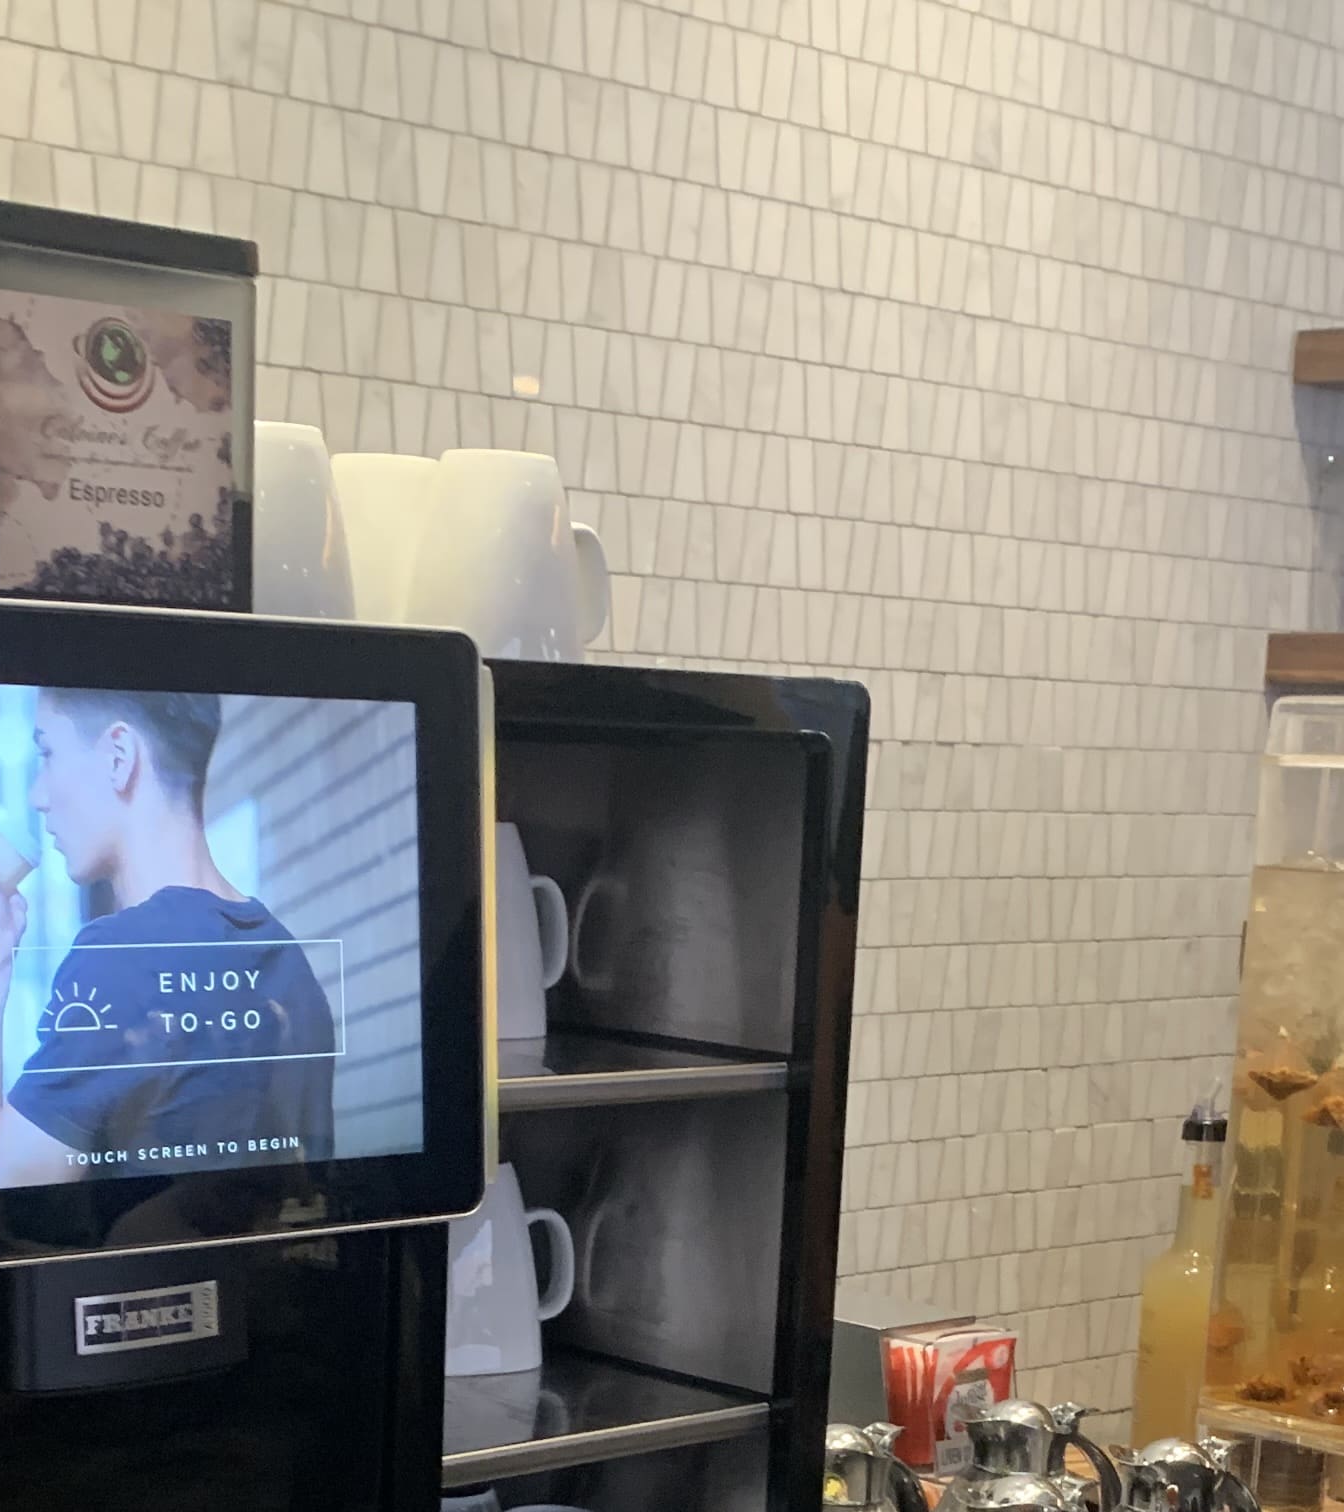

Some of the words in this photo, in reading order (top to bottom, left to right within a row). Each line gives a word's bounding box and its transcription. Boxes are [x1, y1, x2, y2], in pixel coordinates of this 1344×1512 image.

[68, 478, 165, 508] Espresso
[158, 970, 261, 993] ENJOY
[159, 1009, 262, 1033] TO-GO
[65, 1150, 128, 1167] TOUCH
[138, 1143, 208, 1161] SCREEN
[217, 1141, 239, 1154] TO
[247, 1136, 301, 1152] BEGIN
